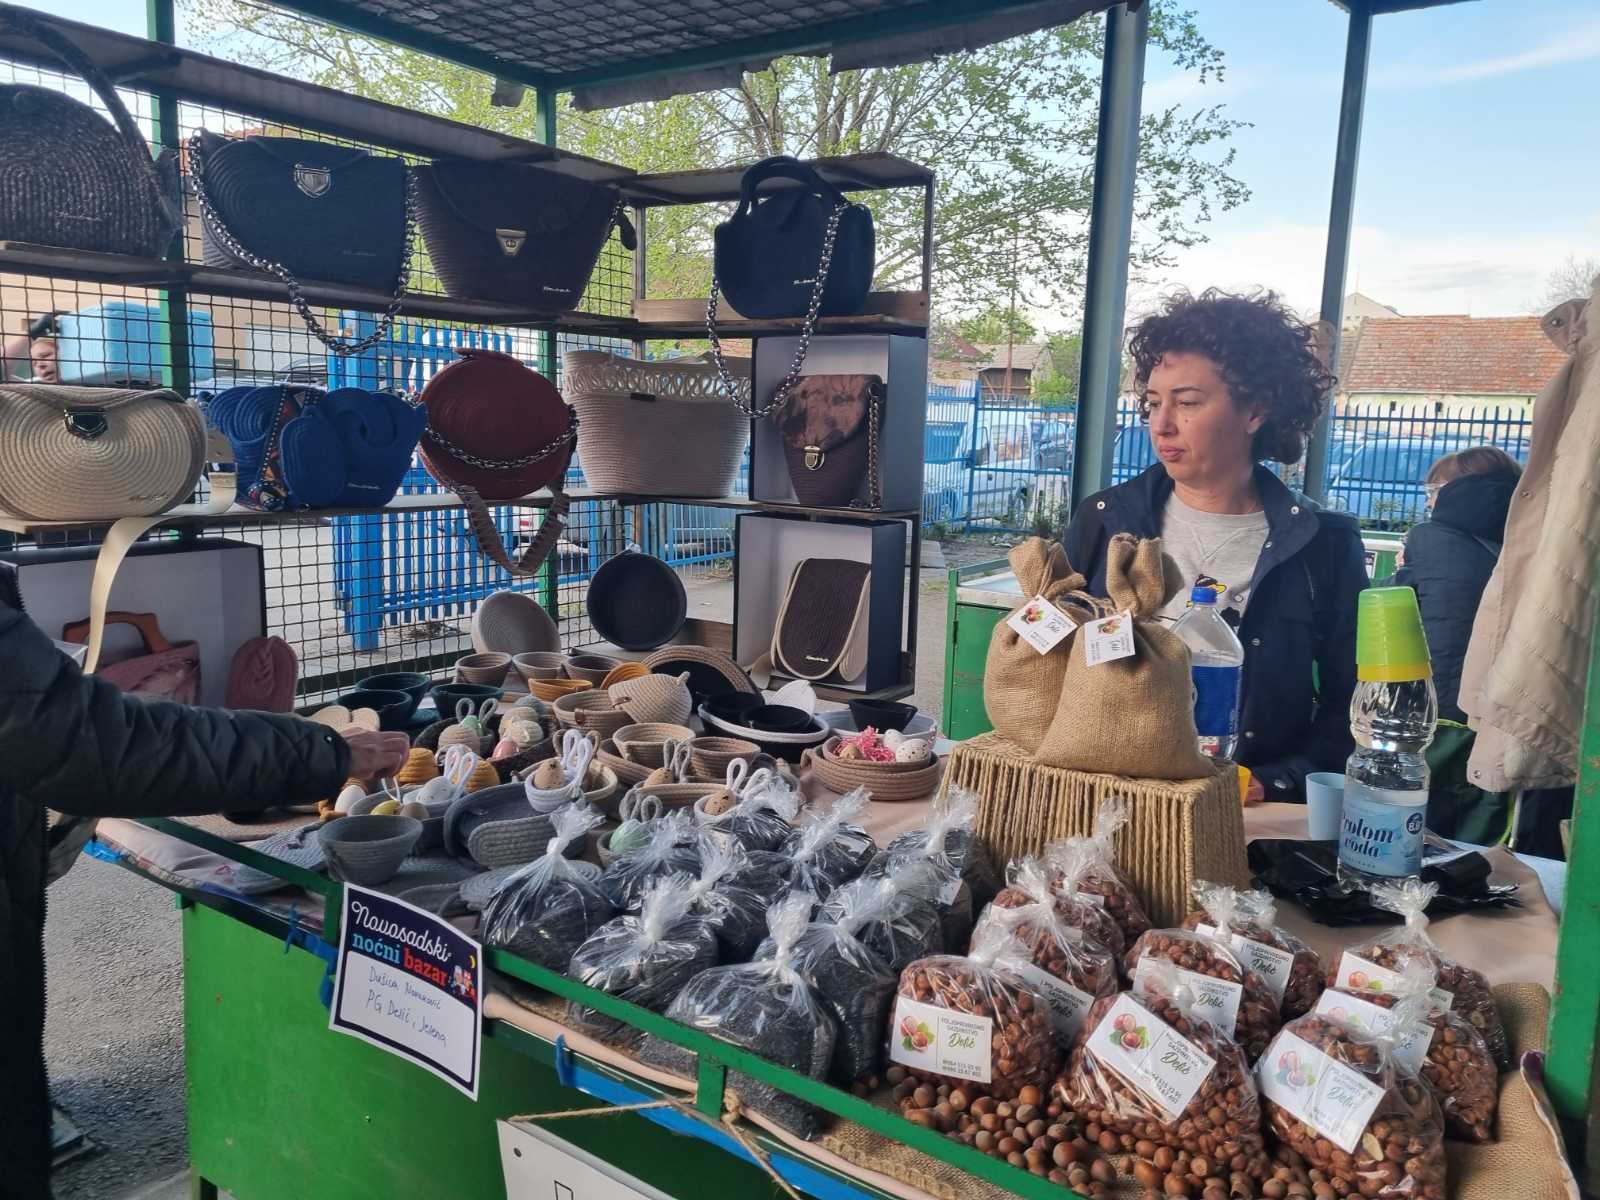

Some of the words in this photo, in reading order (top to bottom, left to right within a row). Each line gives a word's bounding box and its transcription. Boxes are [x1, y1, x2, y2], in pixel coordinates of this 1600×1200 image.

[1345, 838, 1379, 858] voda
[351, 900, 452, 963] Novosadski
[352, 933, 400, 964] noćni
[403, 947, 447, 987] bazar
[365, 989, 382, 1014] PG
[949, 1032, 976, 1049] Delić
[1160, 1051, 1191, 1075] Delić
